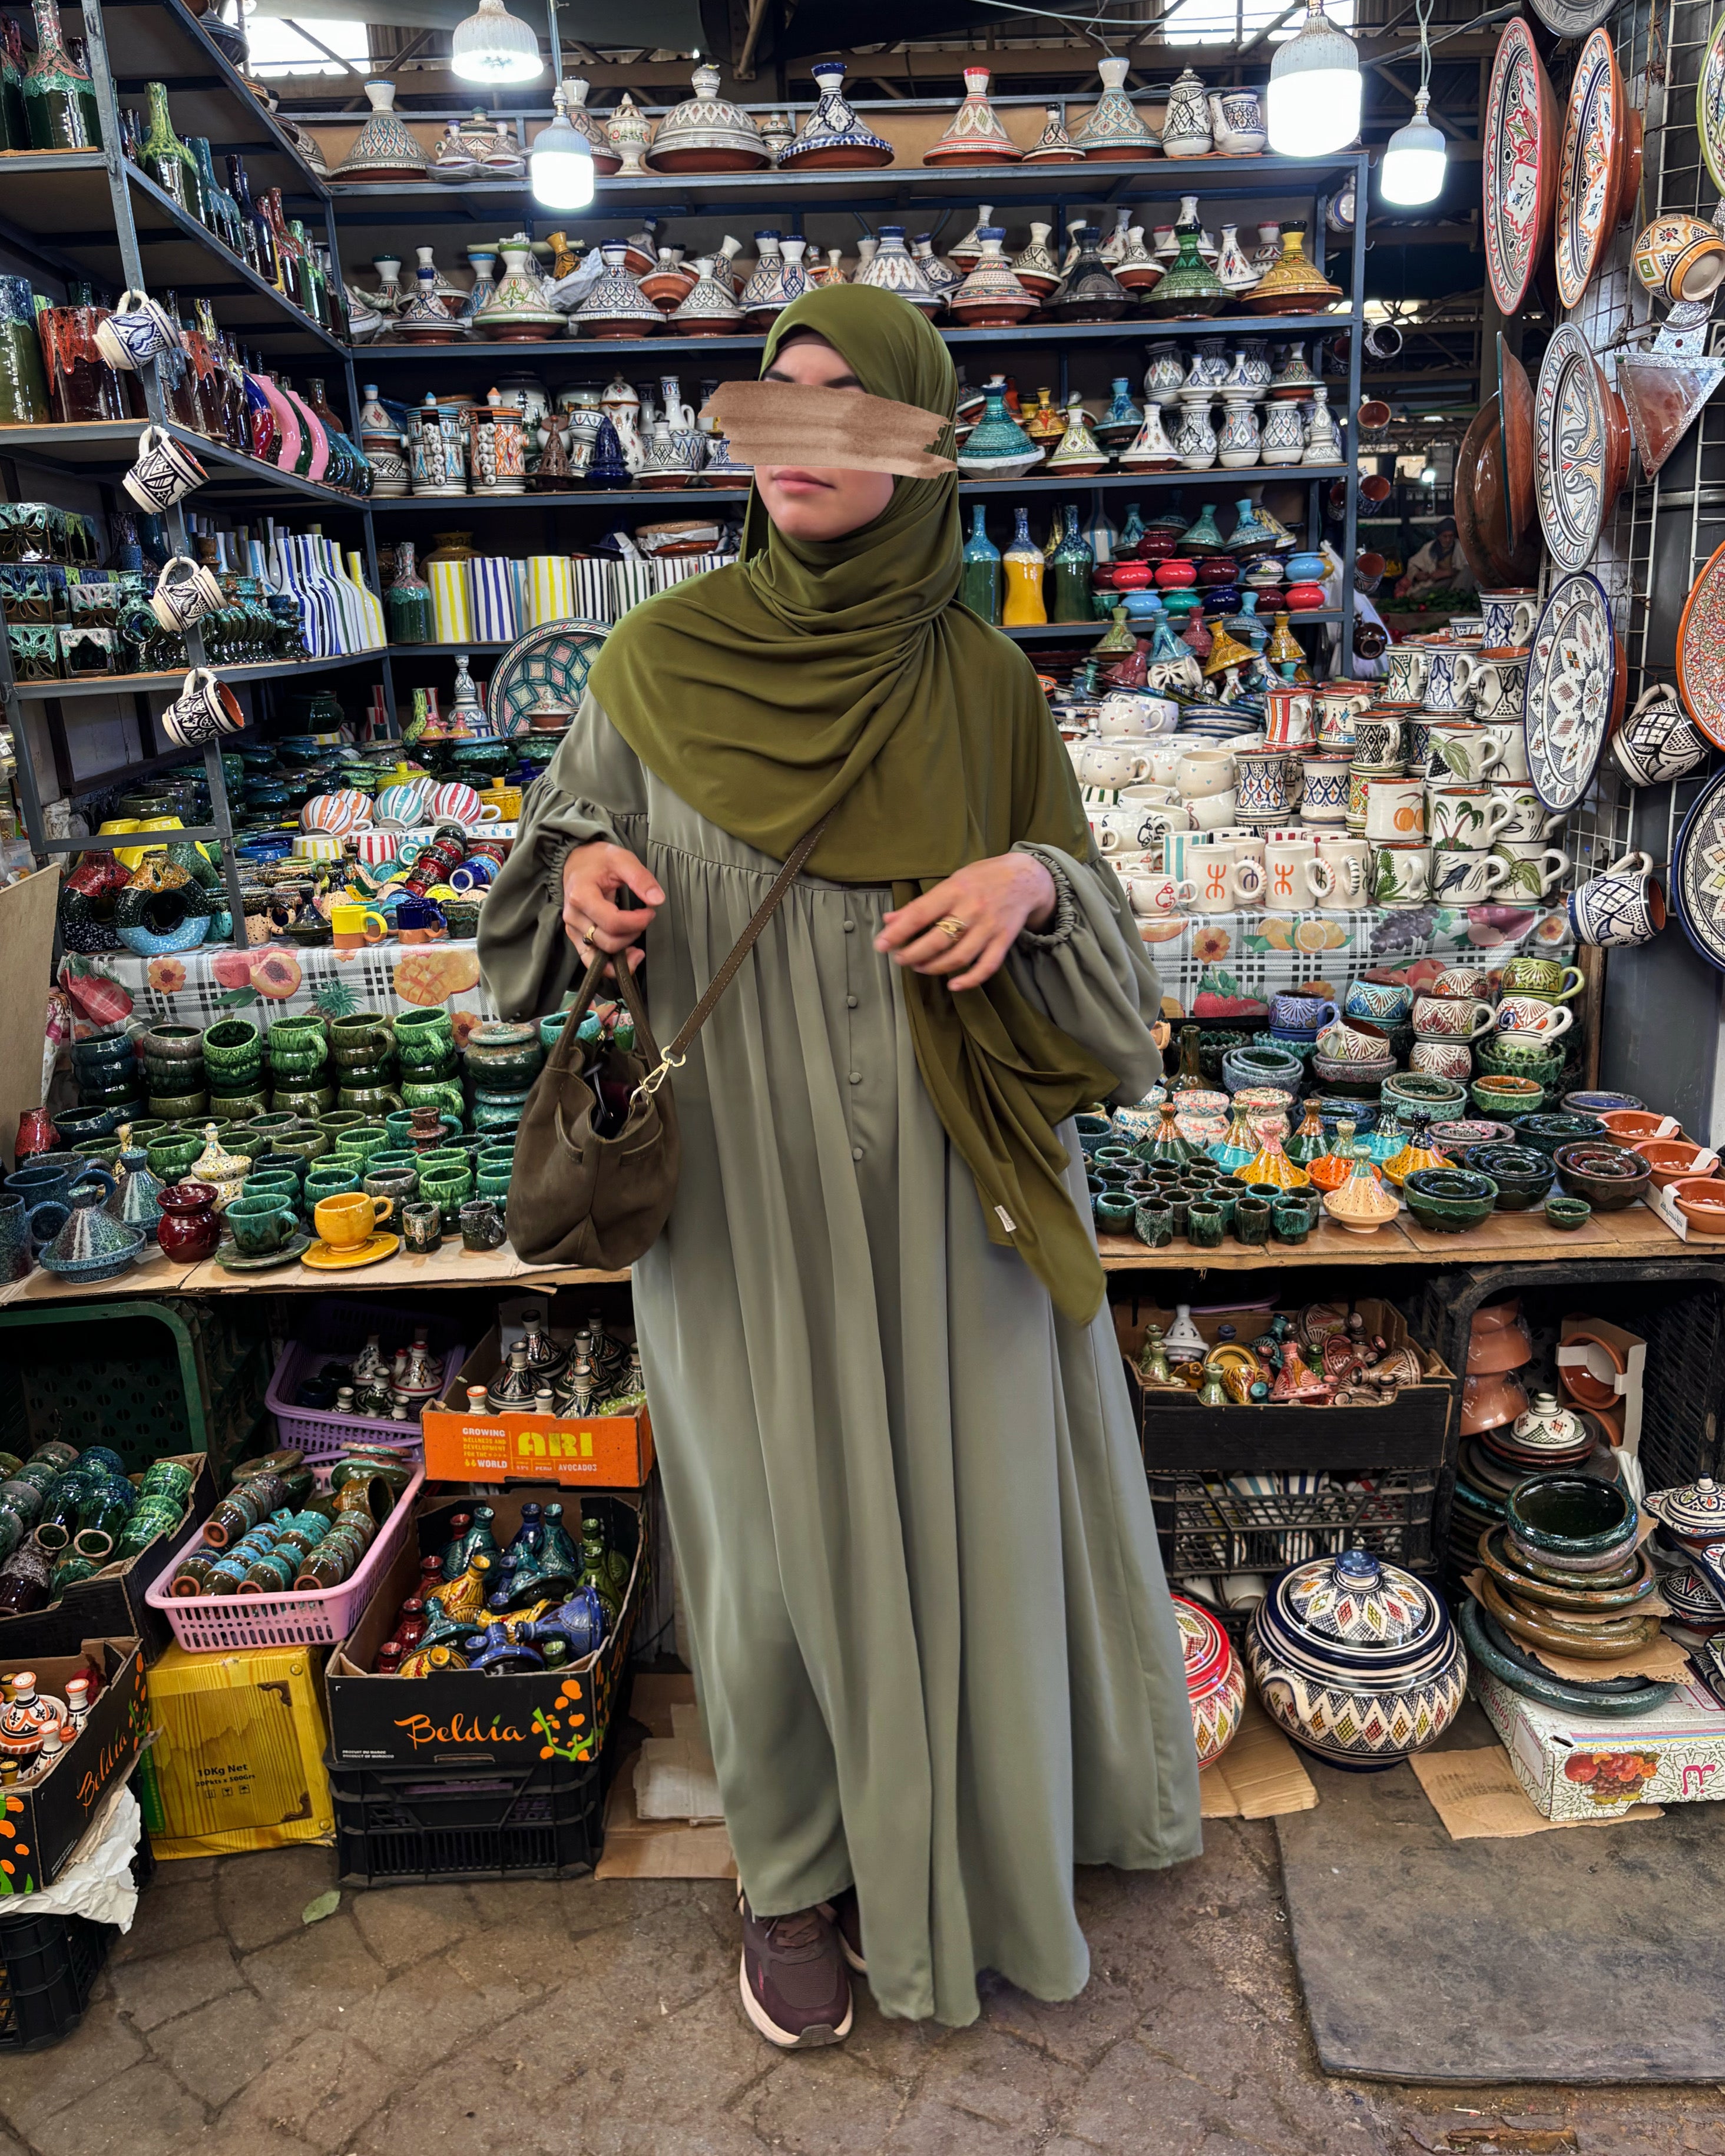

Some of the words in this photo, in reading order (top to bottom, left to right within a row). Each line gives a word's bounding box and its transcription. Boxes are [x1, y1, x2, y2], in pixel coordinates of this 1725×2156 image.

[462, 1428, 505, 1437] GROWING
[463, 1443, 506, 1452] DEVELOPMENT
[518, 1432, 594, 1457] ARI
[477, 1459, 507, 1468] WORLD
[558, 1463, 597, 1472] AVOCADOS
[394, 1713, 526, 1750] Beldia
[198, 1767, 225, 1777] 10Kg
[227, 1764, 248, 1773] Net
[230, 1774, 256, 1782] 500Grs
